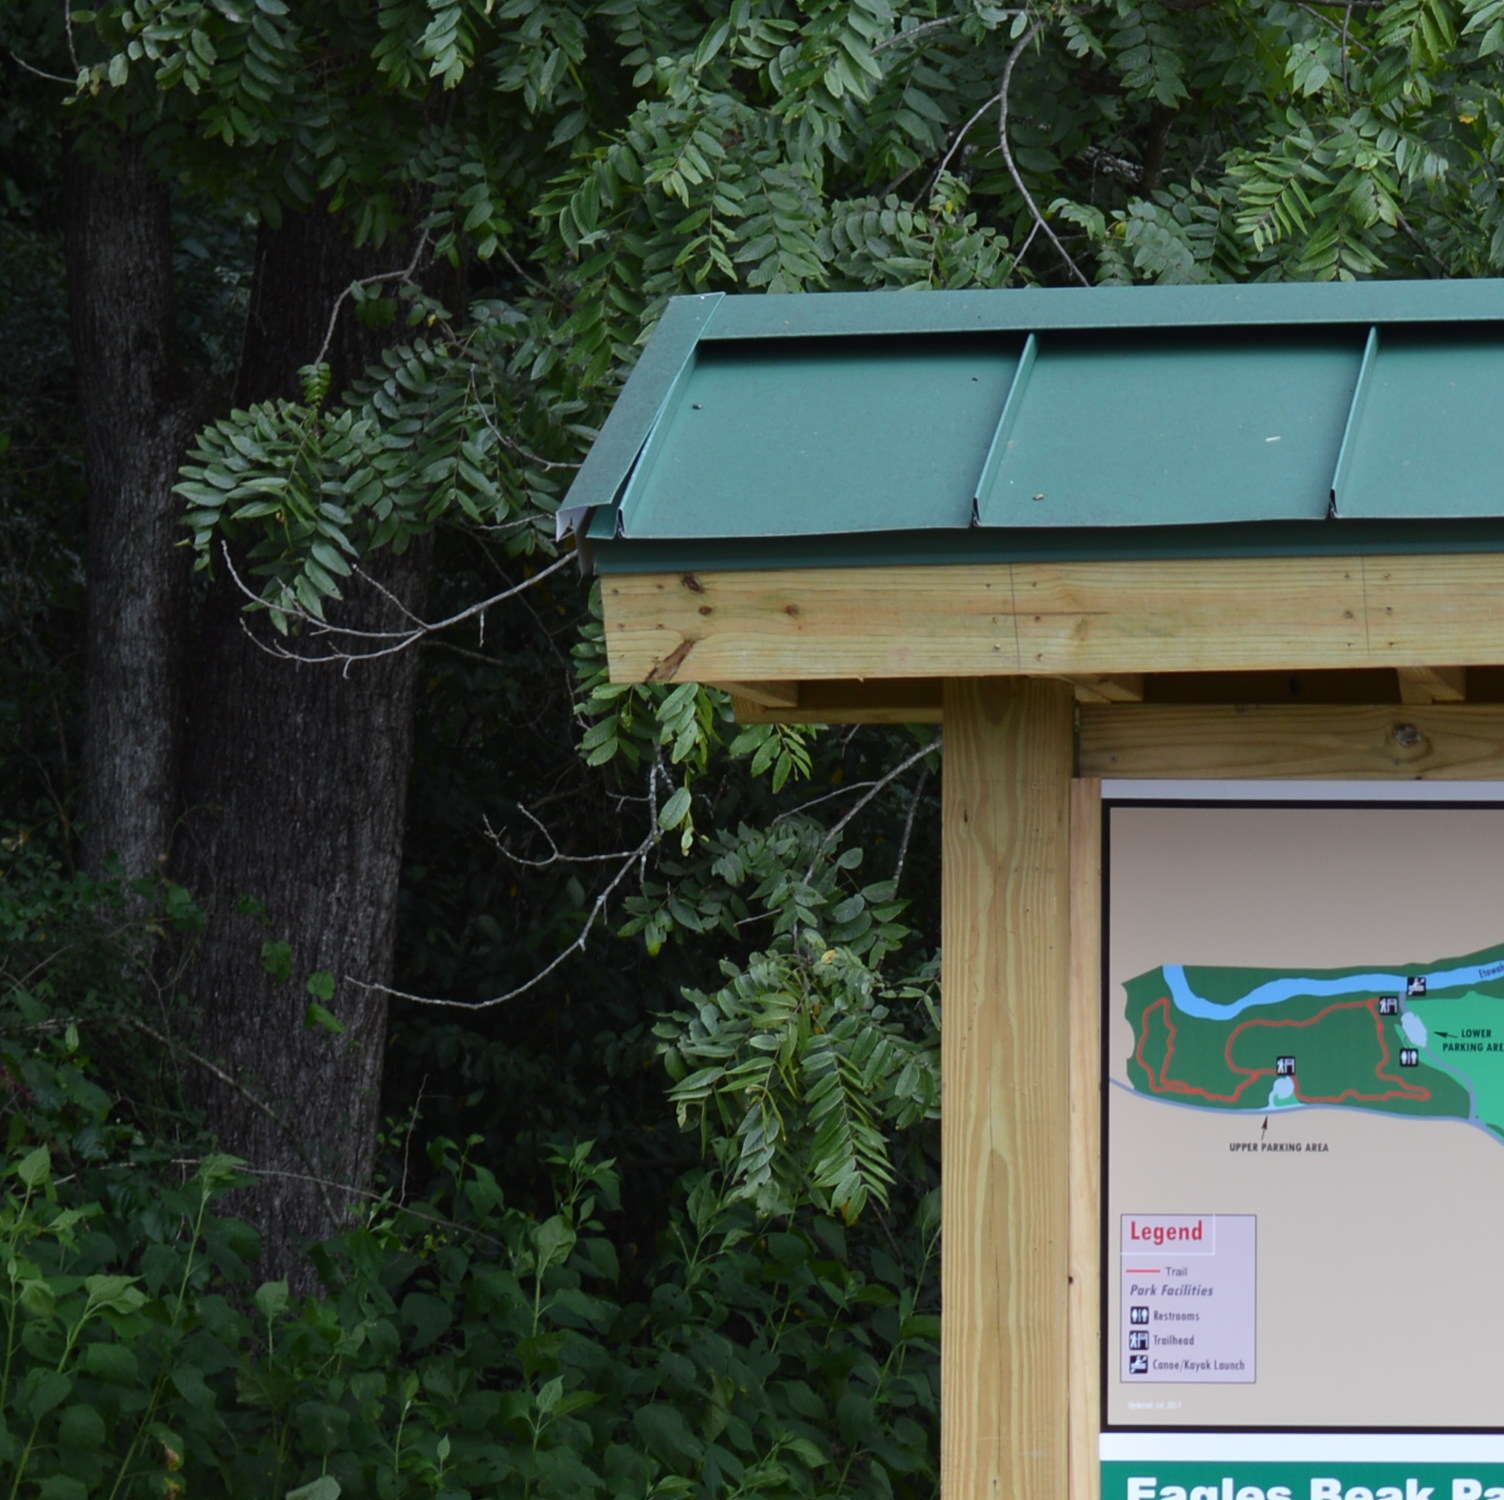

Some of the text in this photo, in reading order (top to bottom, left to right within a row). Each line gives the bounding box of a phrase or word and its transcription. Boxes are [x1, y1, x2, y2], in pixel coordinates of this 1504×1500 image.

[1461, 1028, 1492, 1038] LOWER
[1442, 1042, 1484, 1052] PARKING
[1229, 1142, 1329, 1152] UPPER PARKING AREA
[1130, 1219, 1203, 1246] Legend
[1165, 1266, 1188, 1277] Trail
[1130, 1284, 1214, 1297] Park Facilities
[1153, 1310, 1200, 1321] Restrooms
[1153, 1334, 1195, 1346] Trailhead
[1152, 1359, 1245, 1373] Canoe/Kayak Launch
